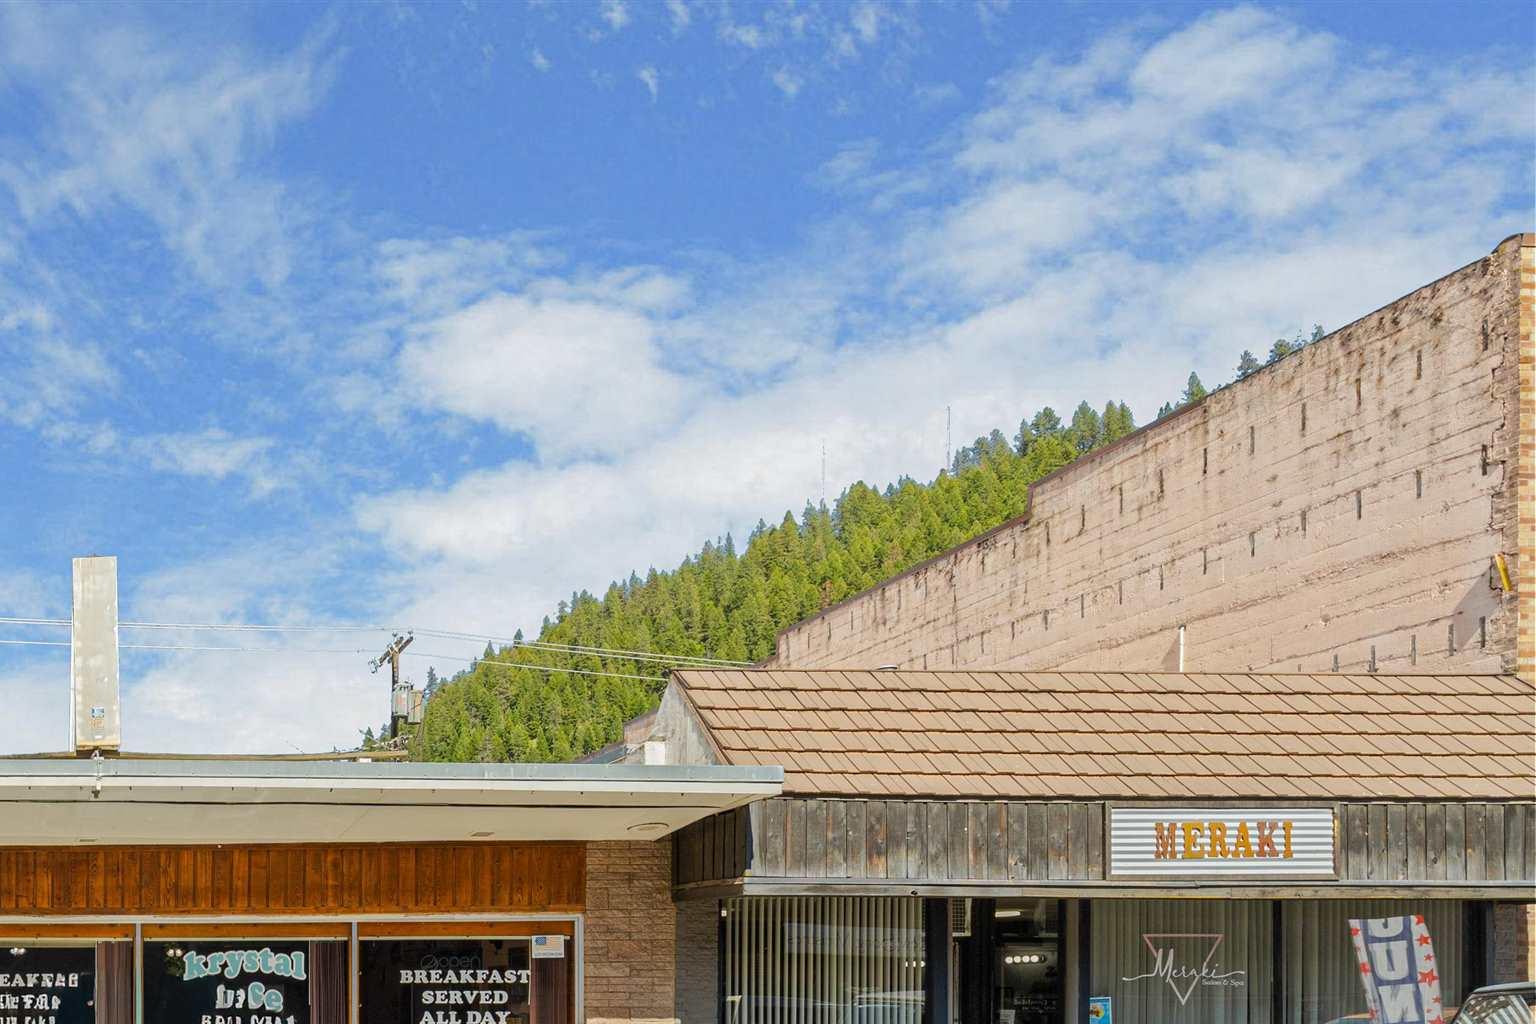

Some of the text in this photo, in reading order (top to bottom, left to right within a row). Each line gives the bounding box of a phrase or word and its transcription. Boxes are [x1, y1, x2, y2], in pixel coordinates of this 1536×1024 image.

[1154, 819, 1294, 860] MERAKI
[1122, 948, 1245, 983] Meraki
[399, 969, 531, 984] BREAKFAST
[421, 990, 509, 1005] SERVED
[419, 1010, 512, 1024] ALL DAY
